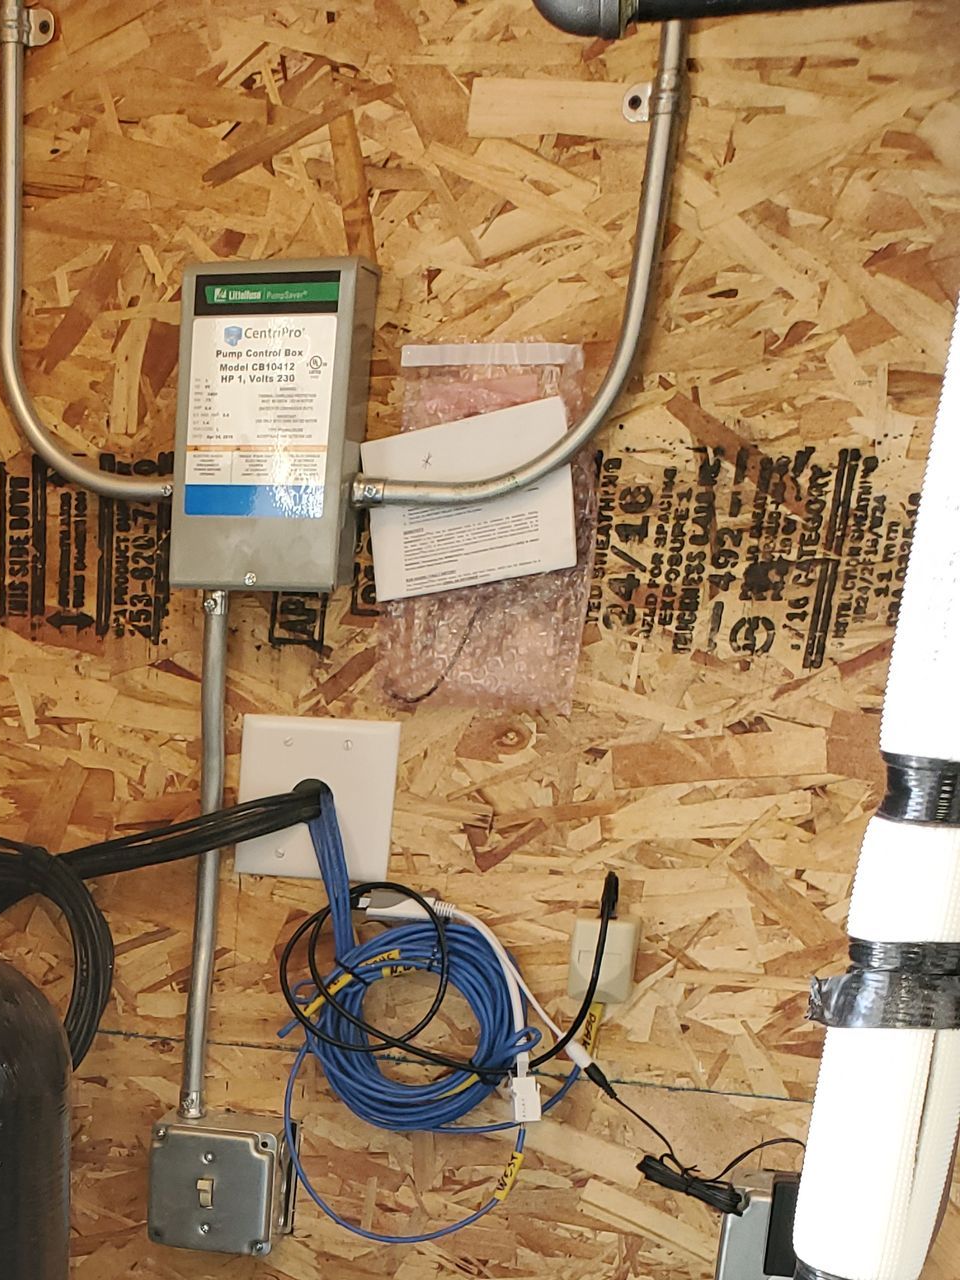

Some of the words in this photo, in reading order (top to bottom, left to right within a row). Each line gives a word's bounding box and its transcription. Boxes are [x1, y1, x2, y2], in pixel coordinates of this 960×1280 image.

[216, 349, 243, 360] Pump
[246, 348, 282, 358] Control
[285, 348, 303, 357] Box
[220, 362, 249, 372] Model
[251, 362, 295, 371] CB10412
[221, 375, 235, 384] HP
[249, 374, 274, 383] Volts
[277, 374, 295, 383] 230
[601, 484, 653, 631] 24/16
[657, 507, 690, 626] EXPOSURE
